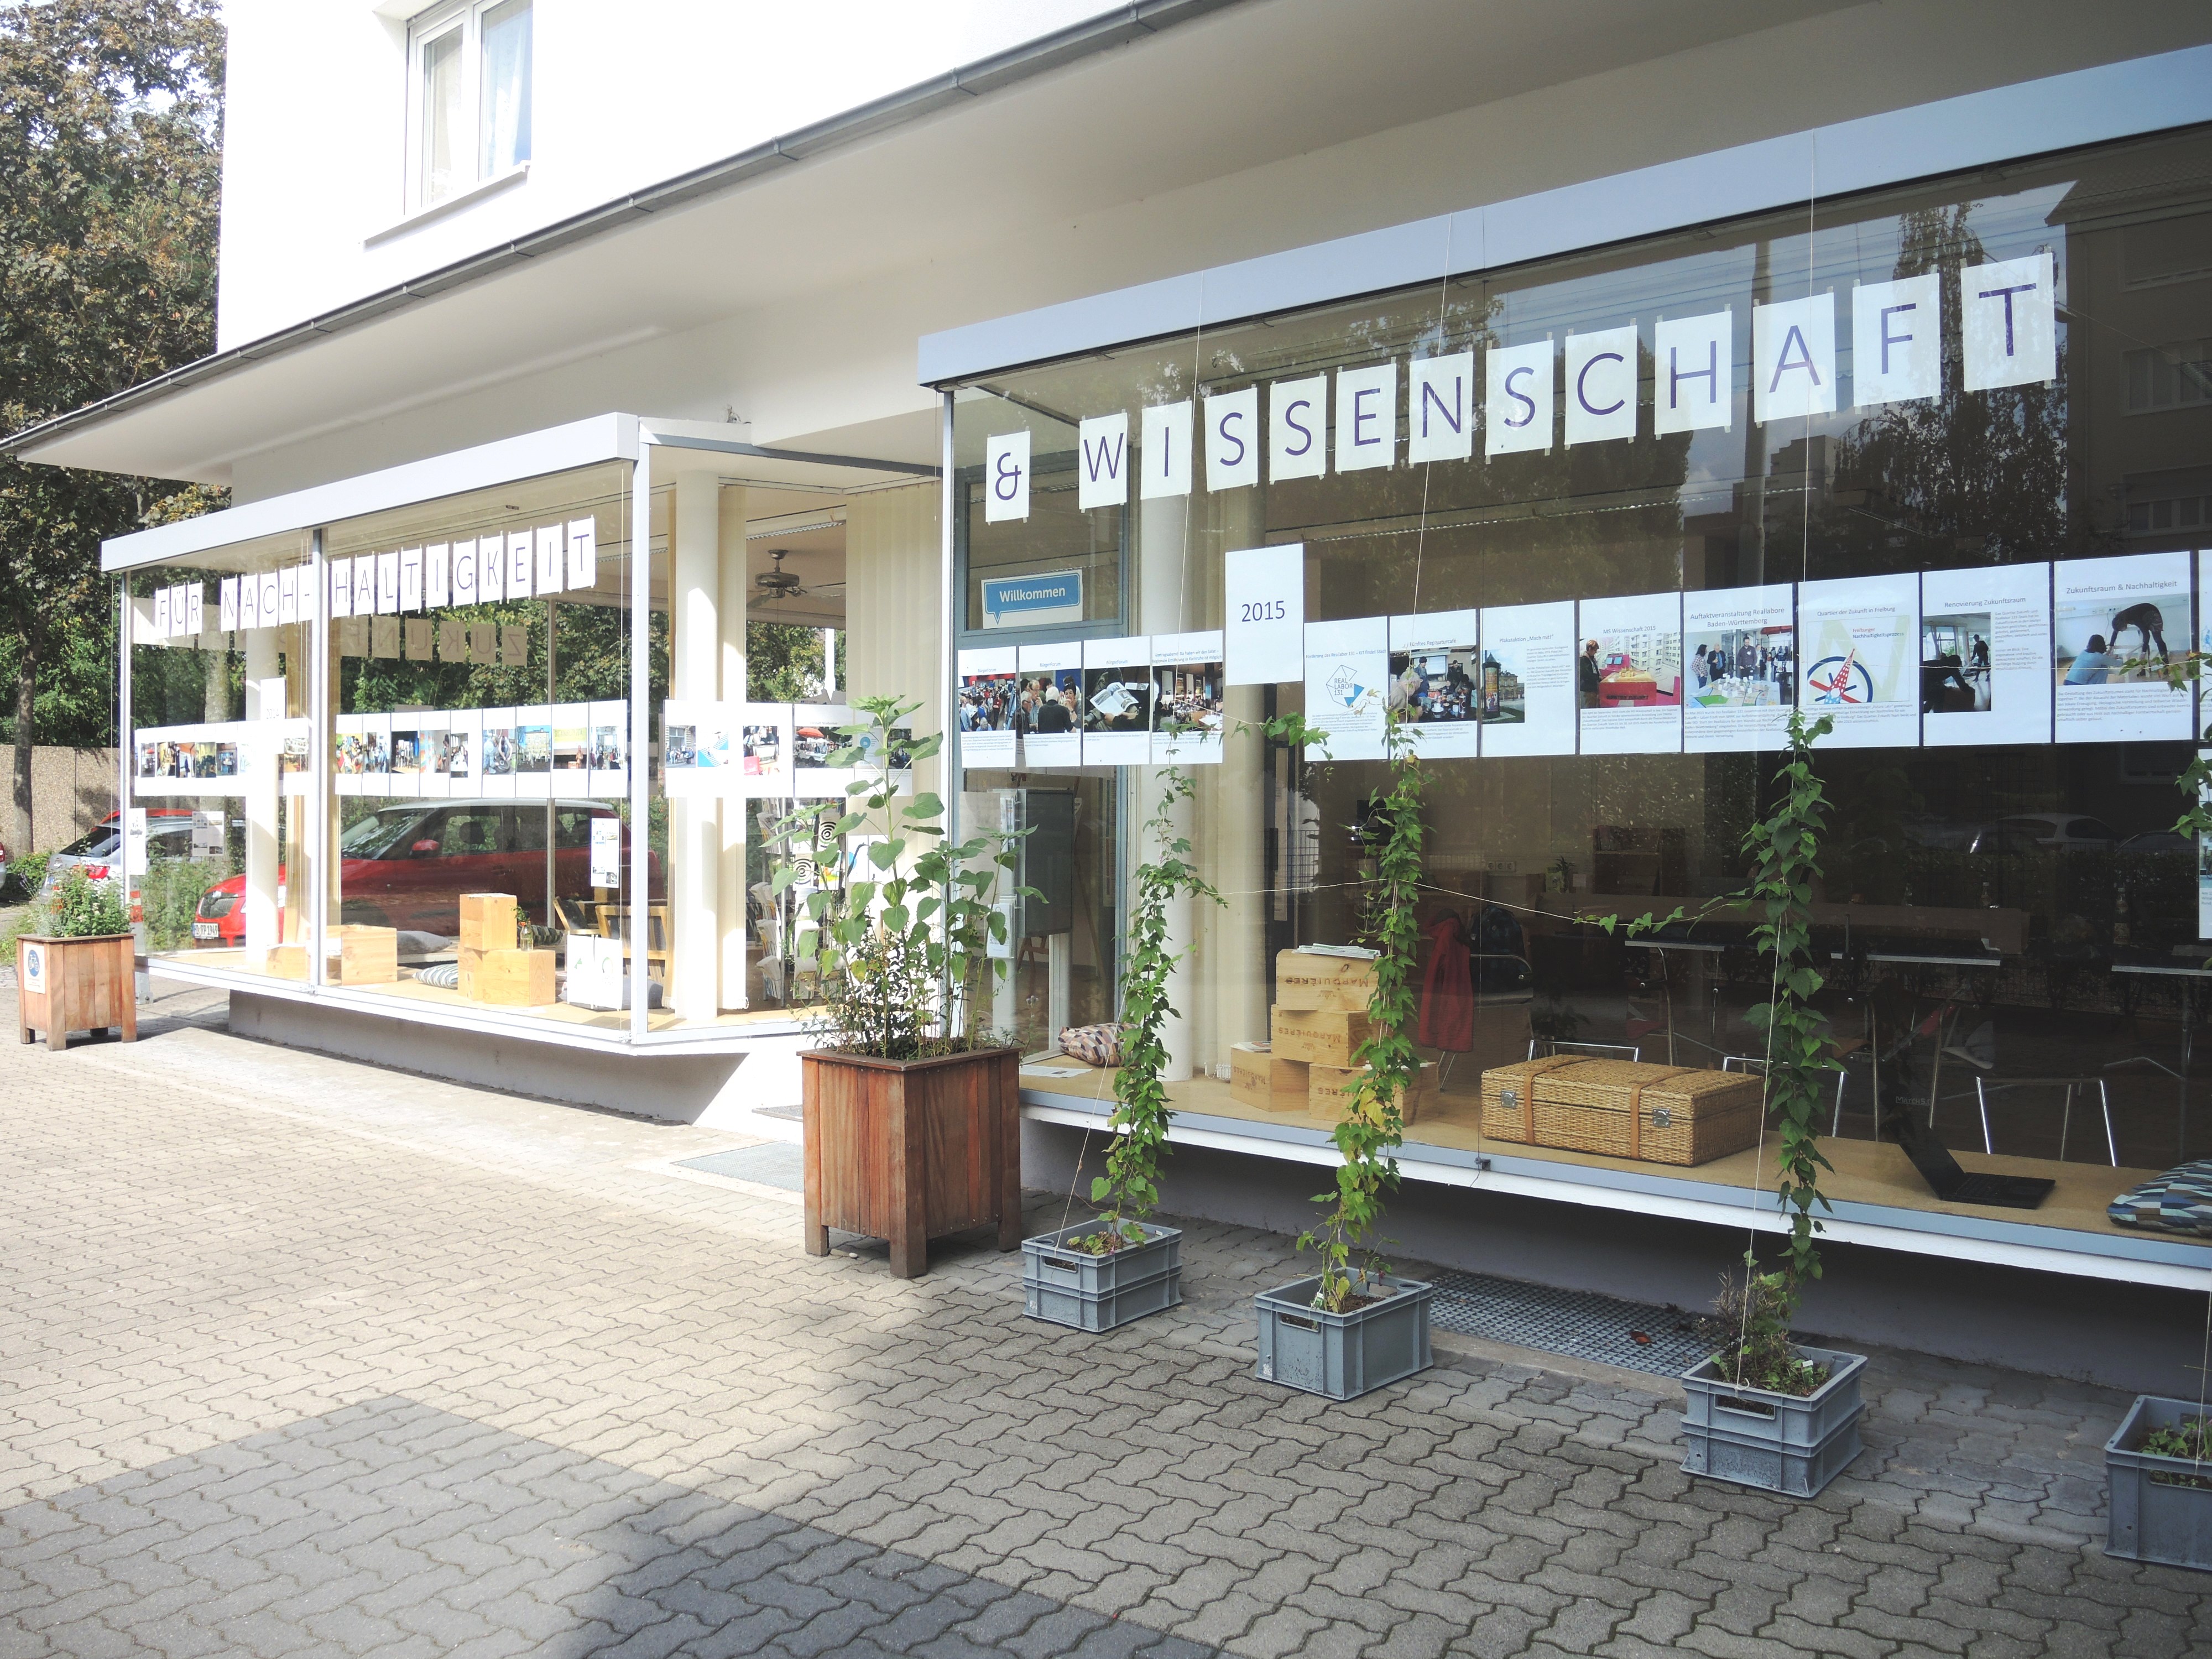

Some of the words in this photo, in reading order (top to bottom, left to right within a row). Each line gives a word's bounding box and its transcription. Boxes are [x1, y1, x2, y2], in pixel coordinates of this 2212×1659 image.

[995, 452, 1022, 501] &
[1083, 283, 2037, 483] WISSENSCHAFT
[160, 591, 199, 627] FÜR
[335, 534, 589, 603] HALTIGKEIT
[2066, 585, 2116, 594] Zukunftsraum
[2125, 580, 2177, 590] Nachhaltigkeit
[999, 587, 1065, 602] Willkommen
[1984, 597, 2026, 606] Zukunftsraum
[1241, 601, 1285, 622] 2015
[1690, 611, 1752, 620] Auftaktveranstaltung
[1707, 618, 1767, 627] Baden-Württemberg
[1278, 1027, 1341, 1043] MARQUIÈRES
